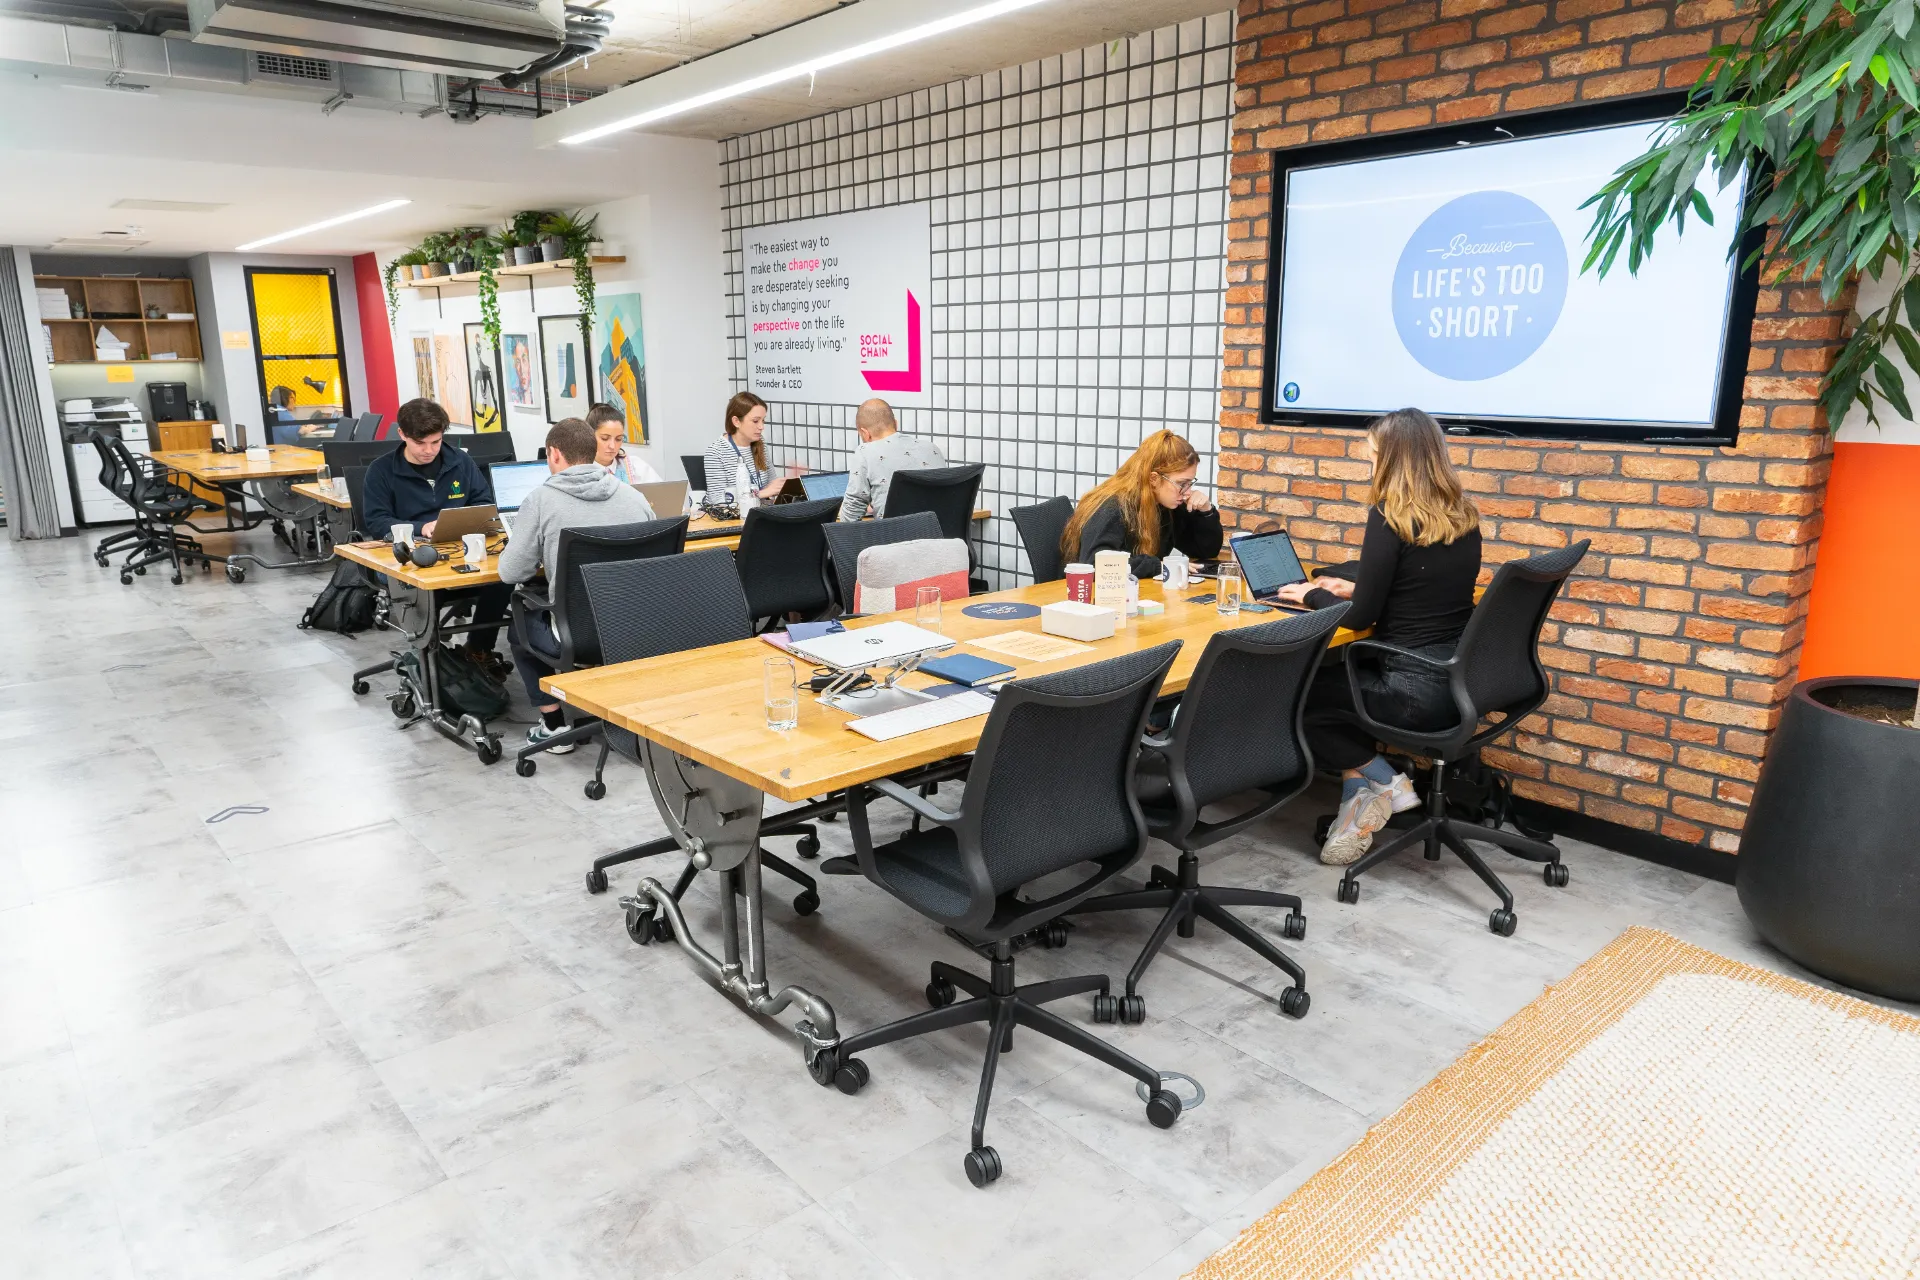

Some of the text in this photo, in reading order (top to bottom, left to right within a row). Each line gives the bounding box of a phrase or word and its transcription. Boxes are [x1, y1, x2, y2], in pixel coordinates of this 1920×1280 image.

[770, 239, 798, 253] easiest
[800, 239, 818, 252] way
[820, 236, 830, 247] to
[1442, 233, 1516, 259] Because
[751, 256, 838, 275] make the change you
[751, 275, 850, 296] are desperately seeking
[1412, 263, 1544, 299] LIFE'S TOO
[752, 298, 831, 315] is by changing your
[753, 315, 845, 334] perspective on the life
[1428, 304, 1519, 338] SHORT
[754, 342, 768, 353] you
[770, 340, 783, 350] are
[785, 337, 815, 352] already
[860, 334, 893, 345] SOCIAL
[861, 347, 888, 358] CHAIN
[755, 365, 802, 375] Steven Bartlett
[755, 379, 802, 389] Founder & CEO
